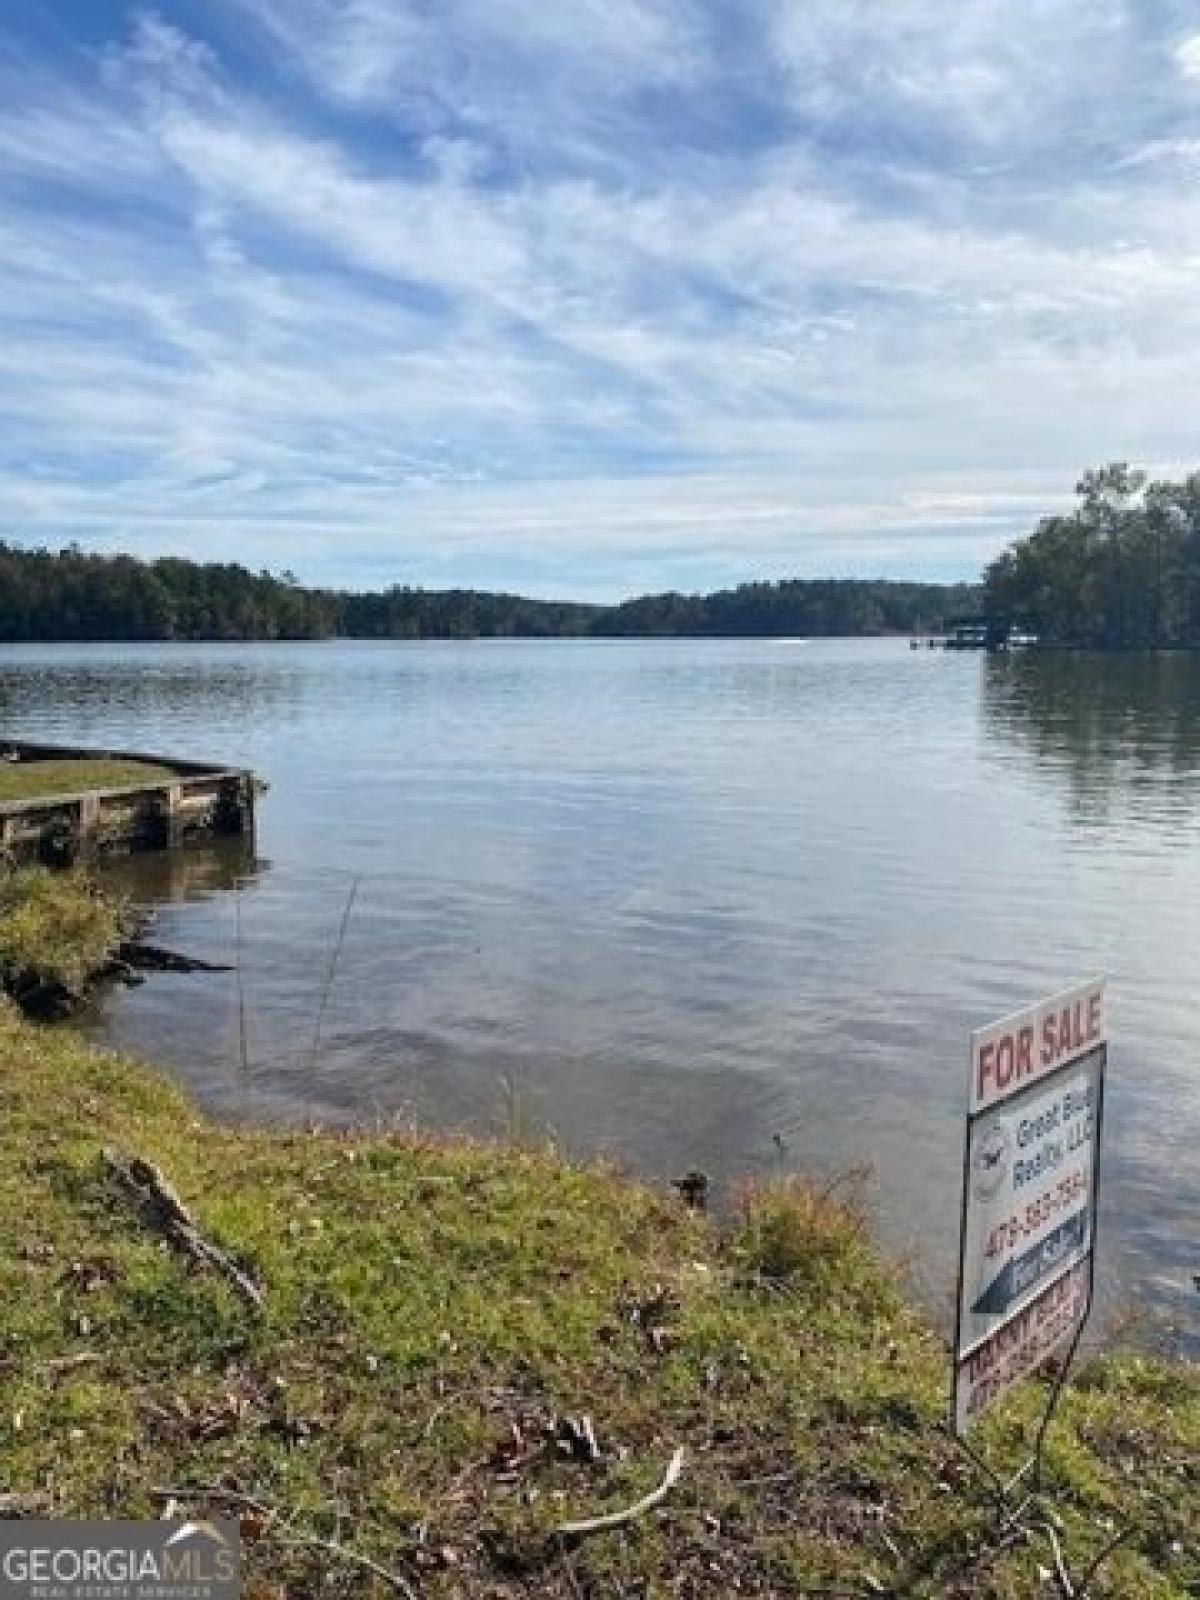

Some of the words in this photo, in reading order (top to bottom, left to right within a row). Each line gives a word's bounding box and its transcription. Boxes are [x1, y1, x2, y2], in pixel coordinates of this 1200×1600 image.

[976, 1026, 1034, 1101] FOR
[1039, 992, 1101, 1065] SALE
[1016, 1102, 1060, 1149] Great
